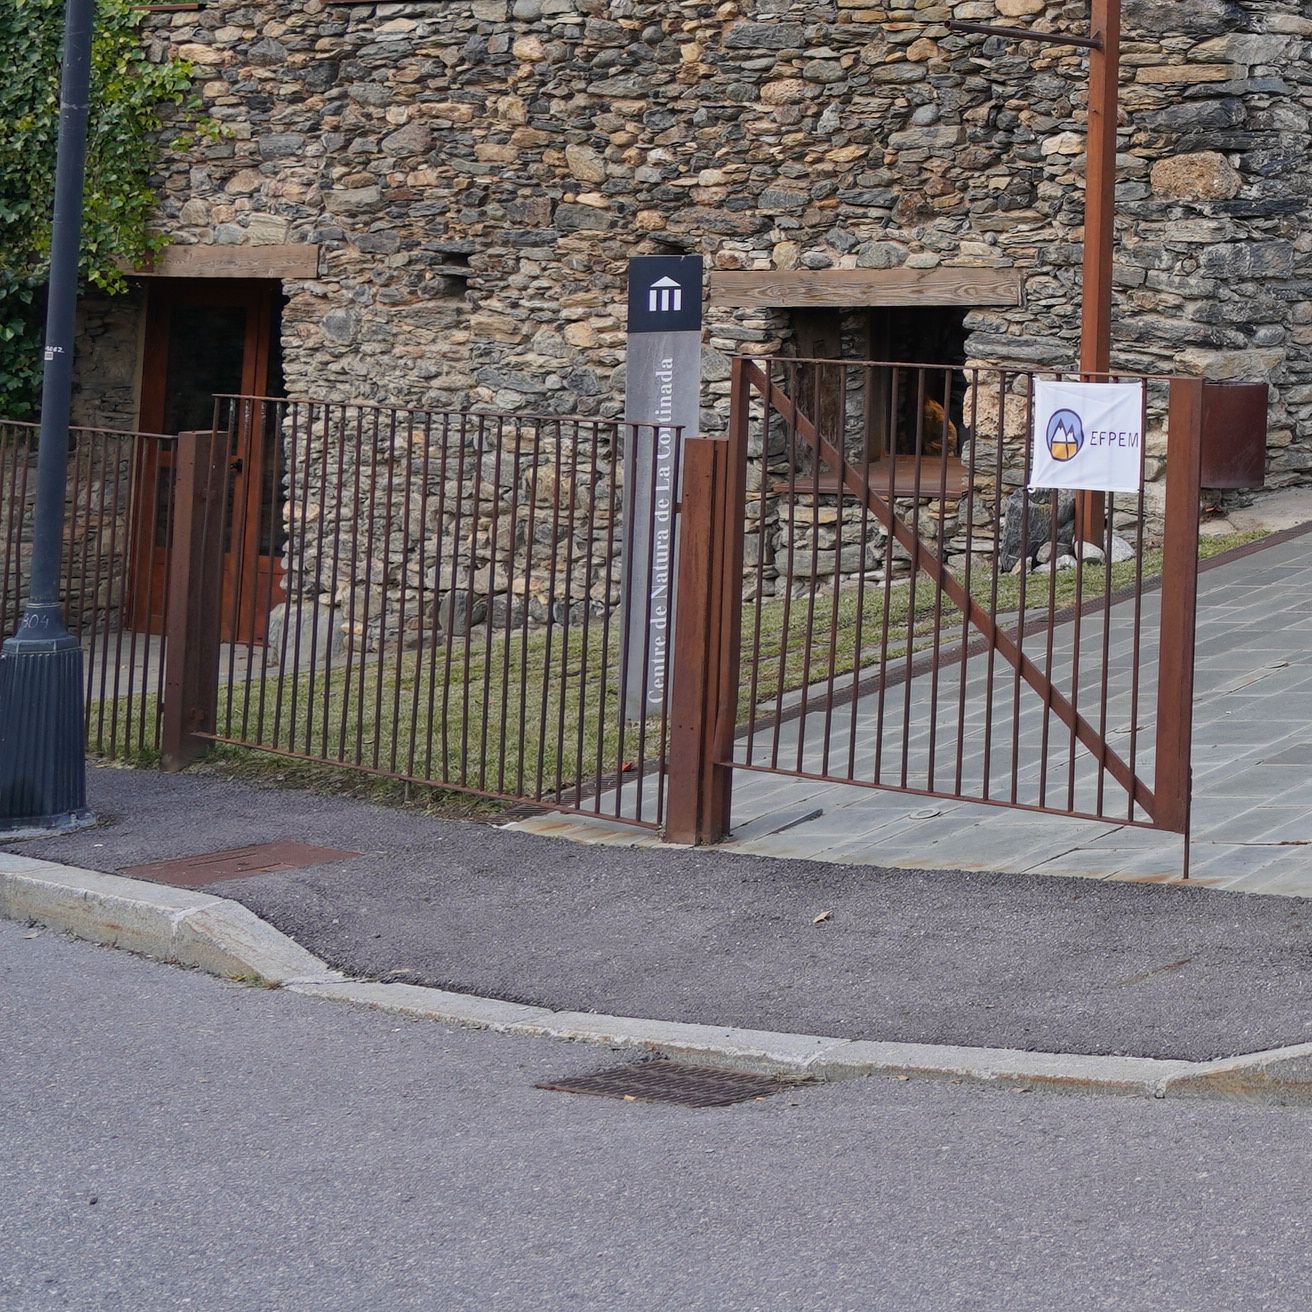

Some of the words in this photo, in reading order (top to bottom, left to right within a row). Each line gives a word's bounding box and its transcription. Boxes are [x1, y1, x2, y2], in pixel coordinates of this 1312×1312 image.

[1090, 431, 1139, 448] EFPEM
[656, 465, 671, 491] La
[655, 498, 670, 522] de
[651, 528, 669, 599] Natura
[650, 605, 668, 630] de
[648, 635, 666, 704] Centre
